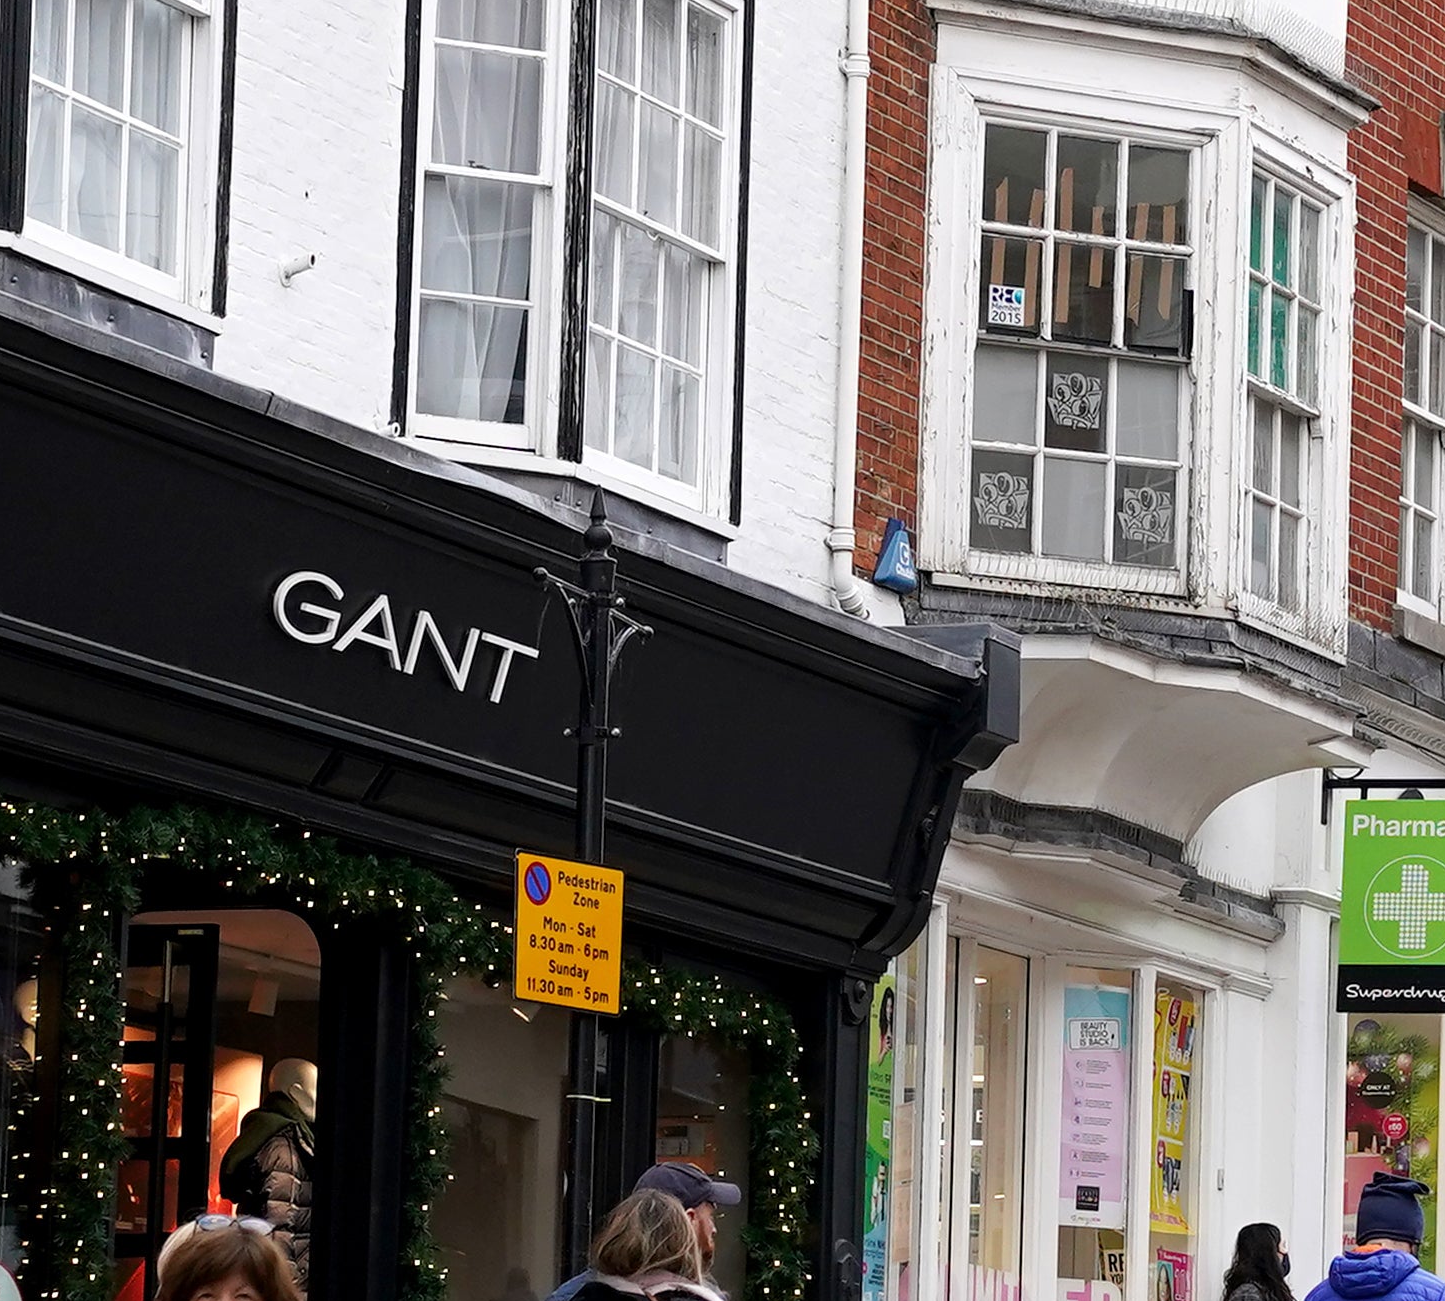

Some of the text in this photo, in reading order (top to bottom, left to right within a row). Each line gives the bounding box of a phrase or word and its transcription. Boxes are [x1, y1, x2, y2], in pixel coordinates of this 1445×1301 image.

[991, 301, 1022, 313] Member
[992, 310, 1022, 326] 2015
[273, 570, 540, 705] GANT
[558, 871, 616, 894] Pedestrian
[573, 892, 600, 909] Zone
[543, 916, 596, 938] Mon Sat
[549, 959, 589, 981] Sunday
[1080, 1022, 1108, 1031] BEAUTY
[1080, 1029, 1108, 1038] STUDIO
[1079, 1037, 1087, 1046] IS
